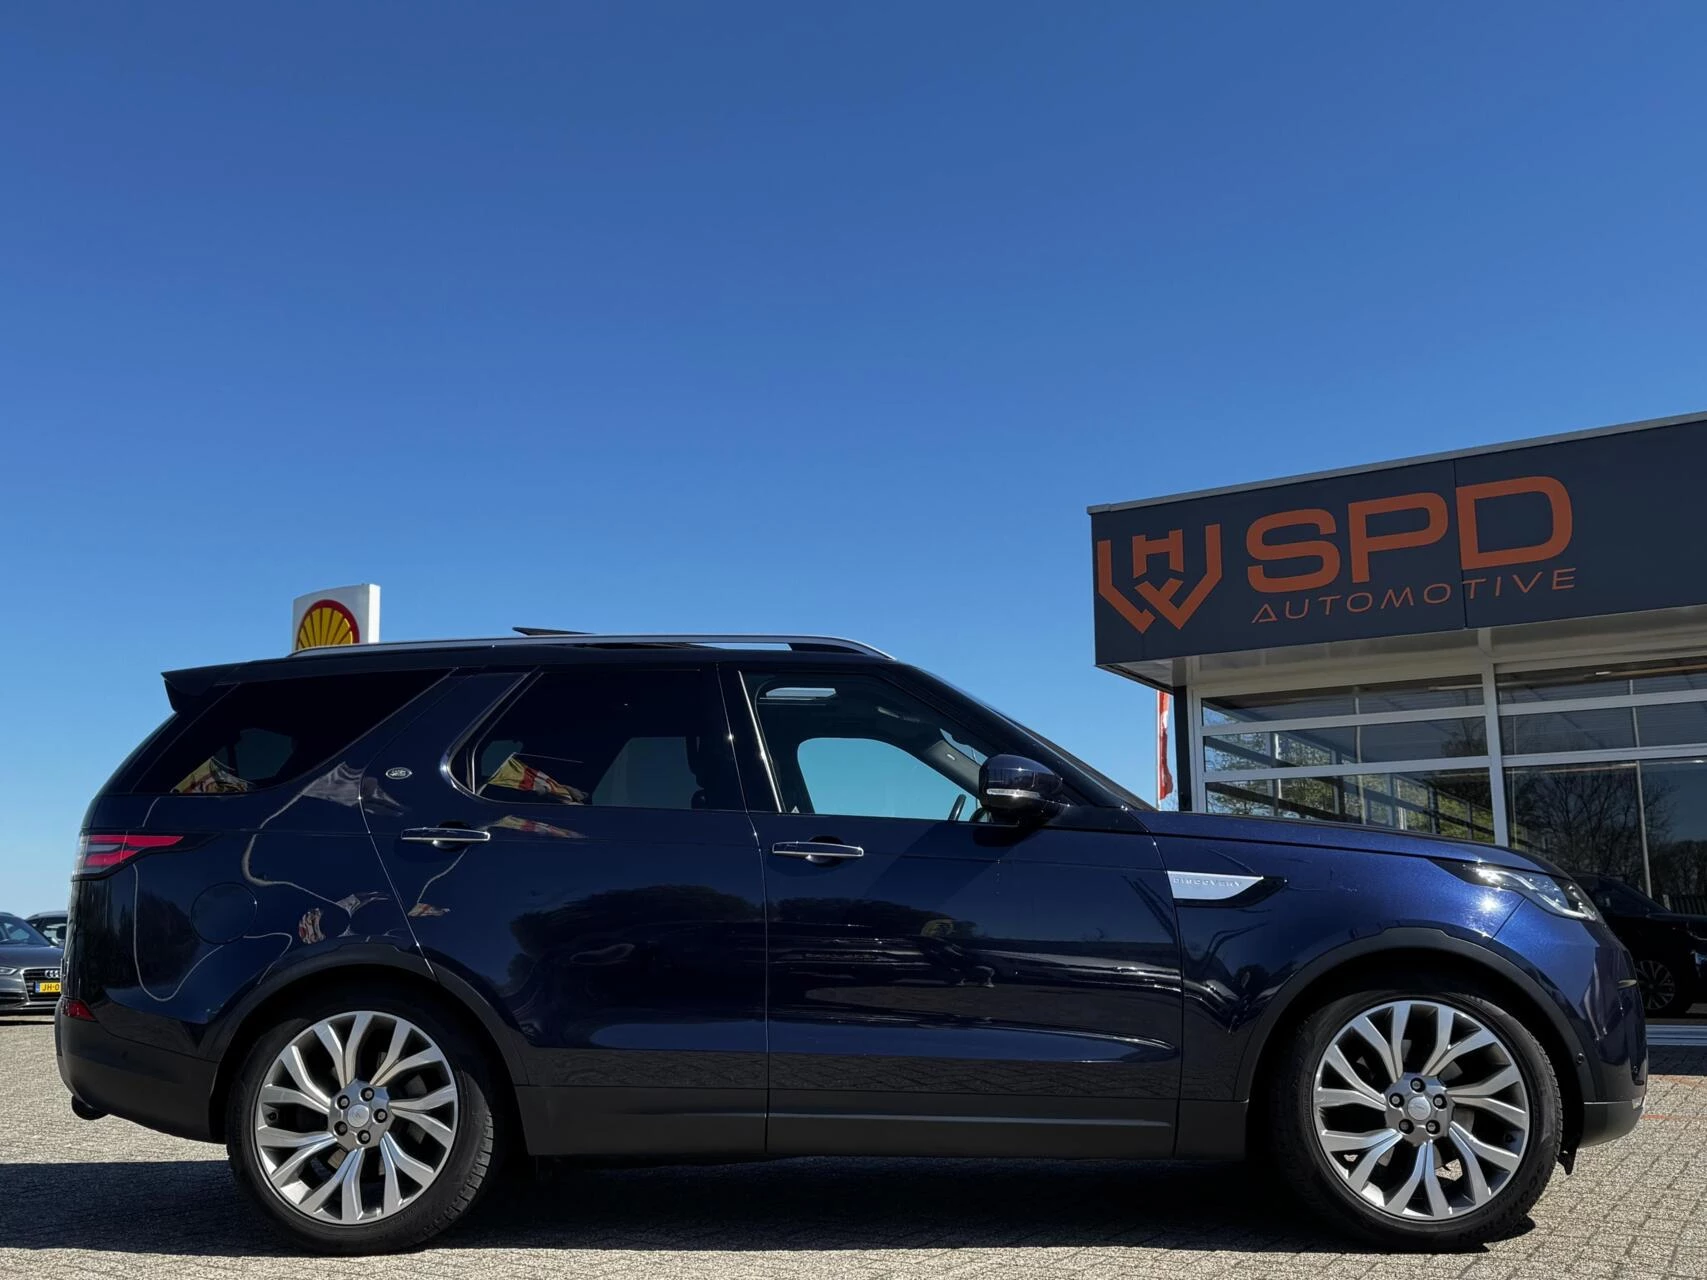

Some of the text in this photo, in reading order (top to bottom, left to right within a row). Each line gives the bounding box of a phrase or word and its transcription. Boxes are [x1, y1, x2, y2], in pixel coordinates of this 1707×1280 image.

[1246, 476, 1573, 593] SPD
[1251, 567, 1577, 624] AUTOMOTIVE
[42, 983, 60, 992] JH-0
